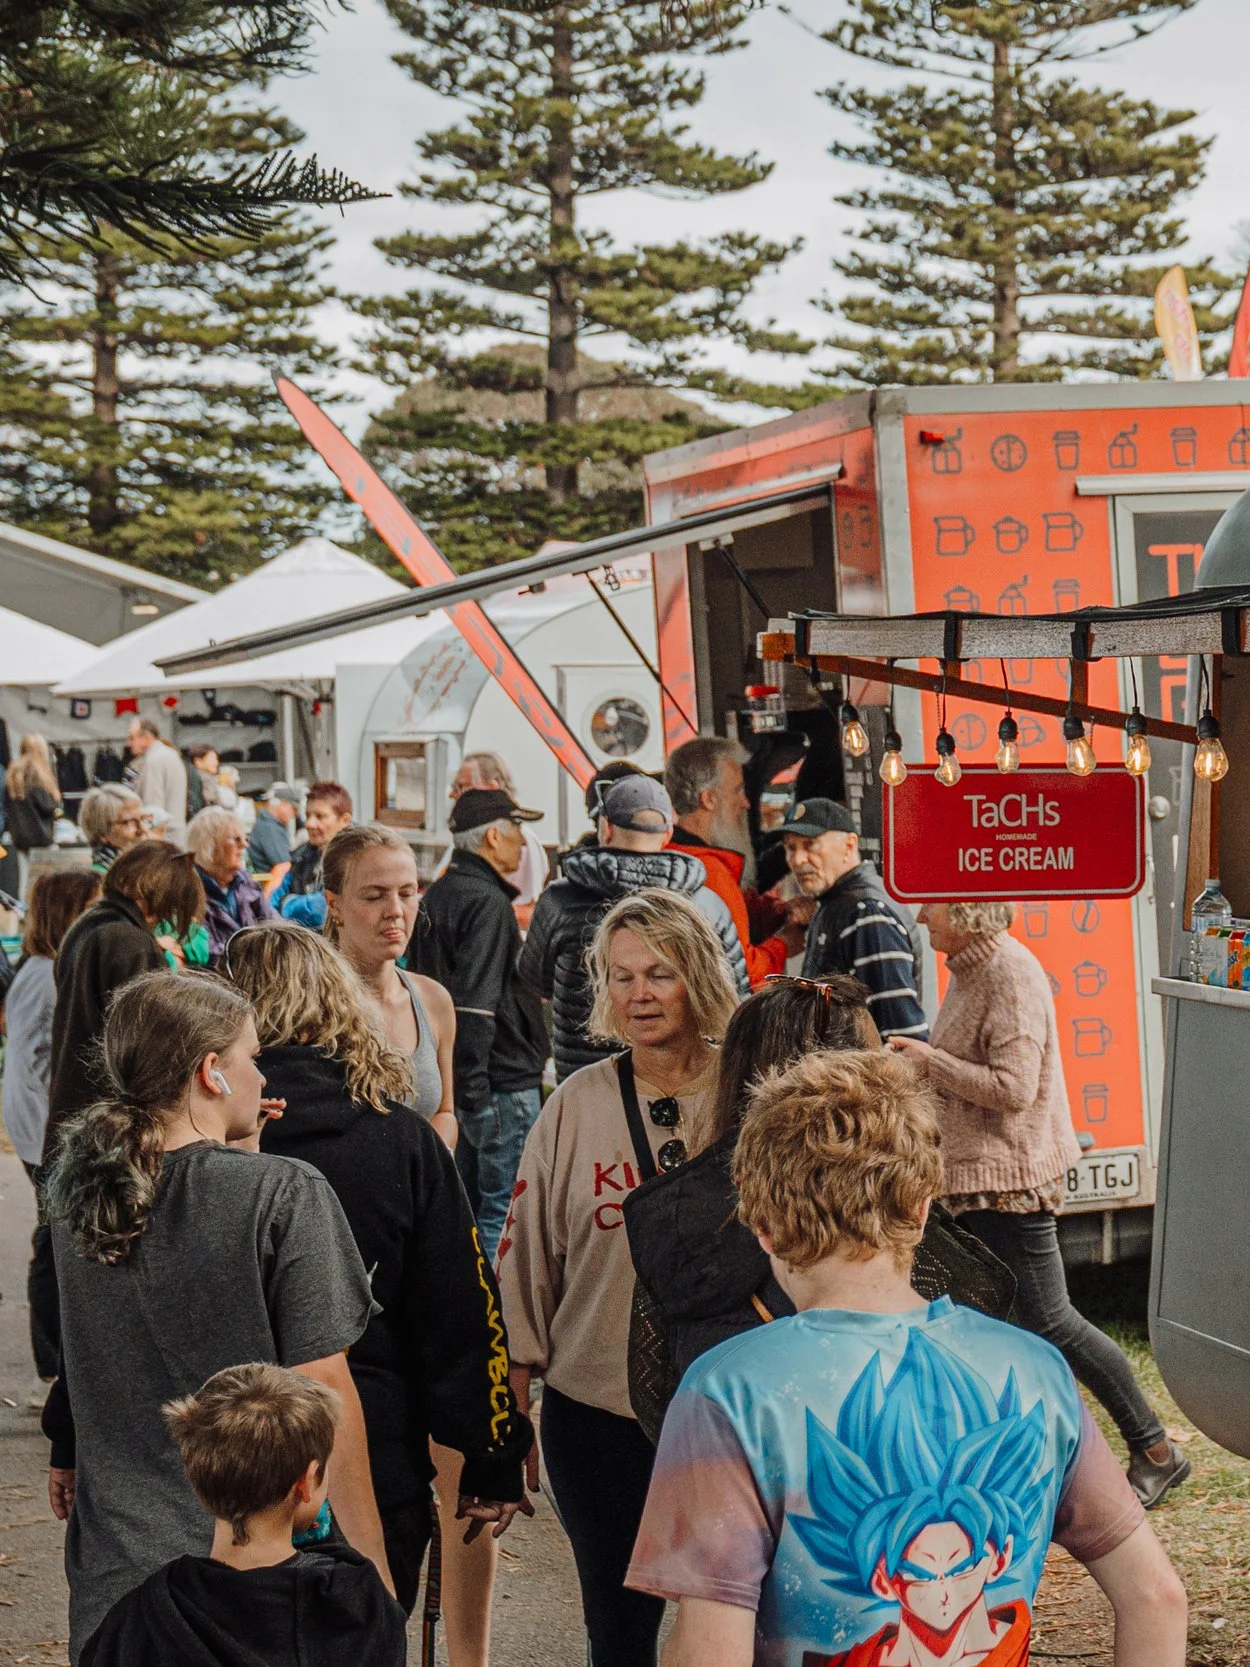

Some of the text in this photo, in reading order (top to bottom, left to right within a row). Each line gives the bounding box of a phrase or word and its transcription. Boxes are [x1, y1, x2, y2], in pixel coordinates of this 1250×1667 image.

[963, 793, 1061, 828] TaCHs
[995, 833, 1038, 841] HOMEMADE
[958, 846, 1075, 872] ICE CREAM
